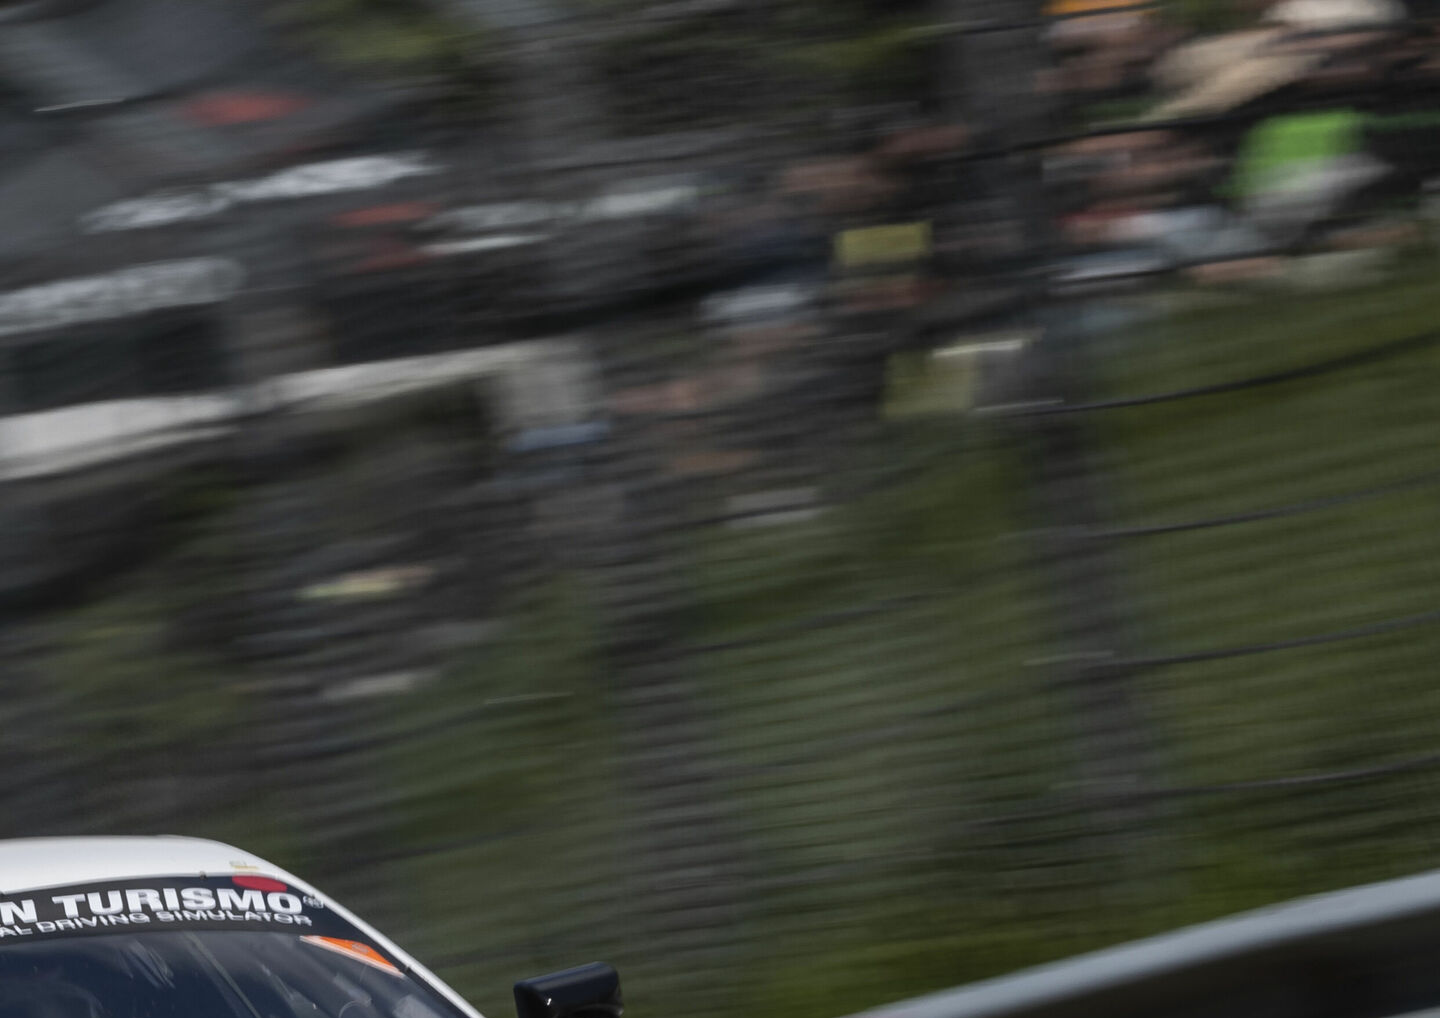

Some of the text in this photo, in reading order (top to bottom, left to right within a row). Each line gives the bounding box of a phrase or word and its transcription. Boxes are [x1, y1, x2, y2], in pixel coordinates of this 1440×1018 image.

[52, 887, 302, 919] TURISMO
[36, 912, 150, 933] DRIVING
[157, 910, 312, 926] SIMULATOR
